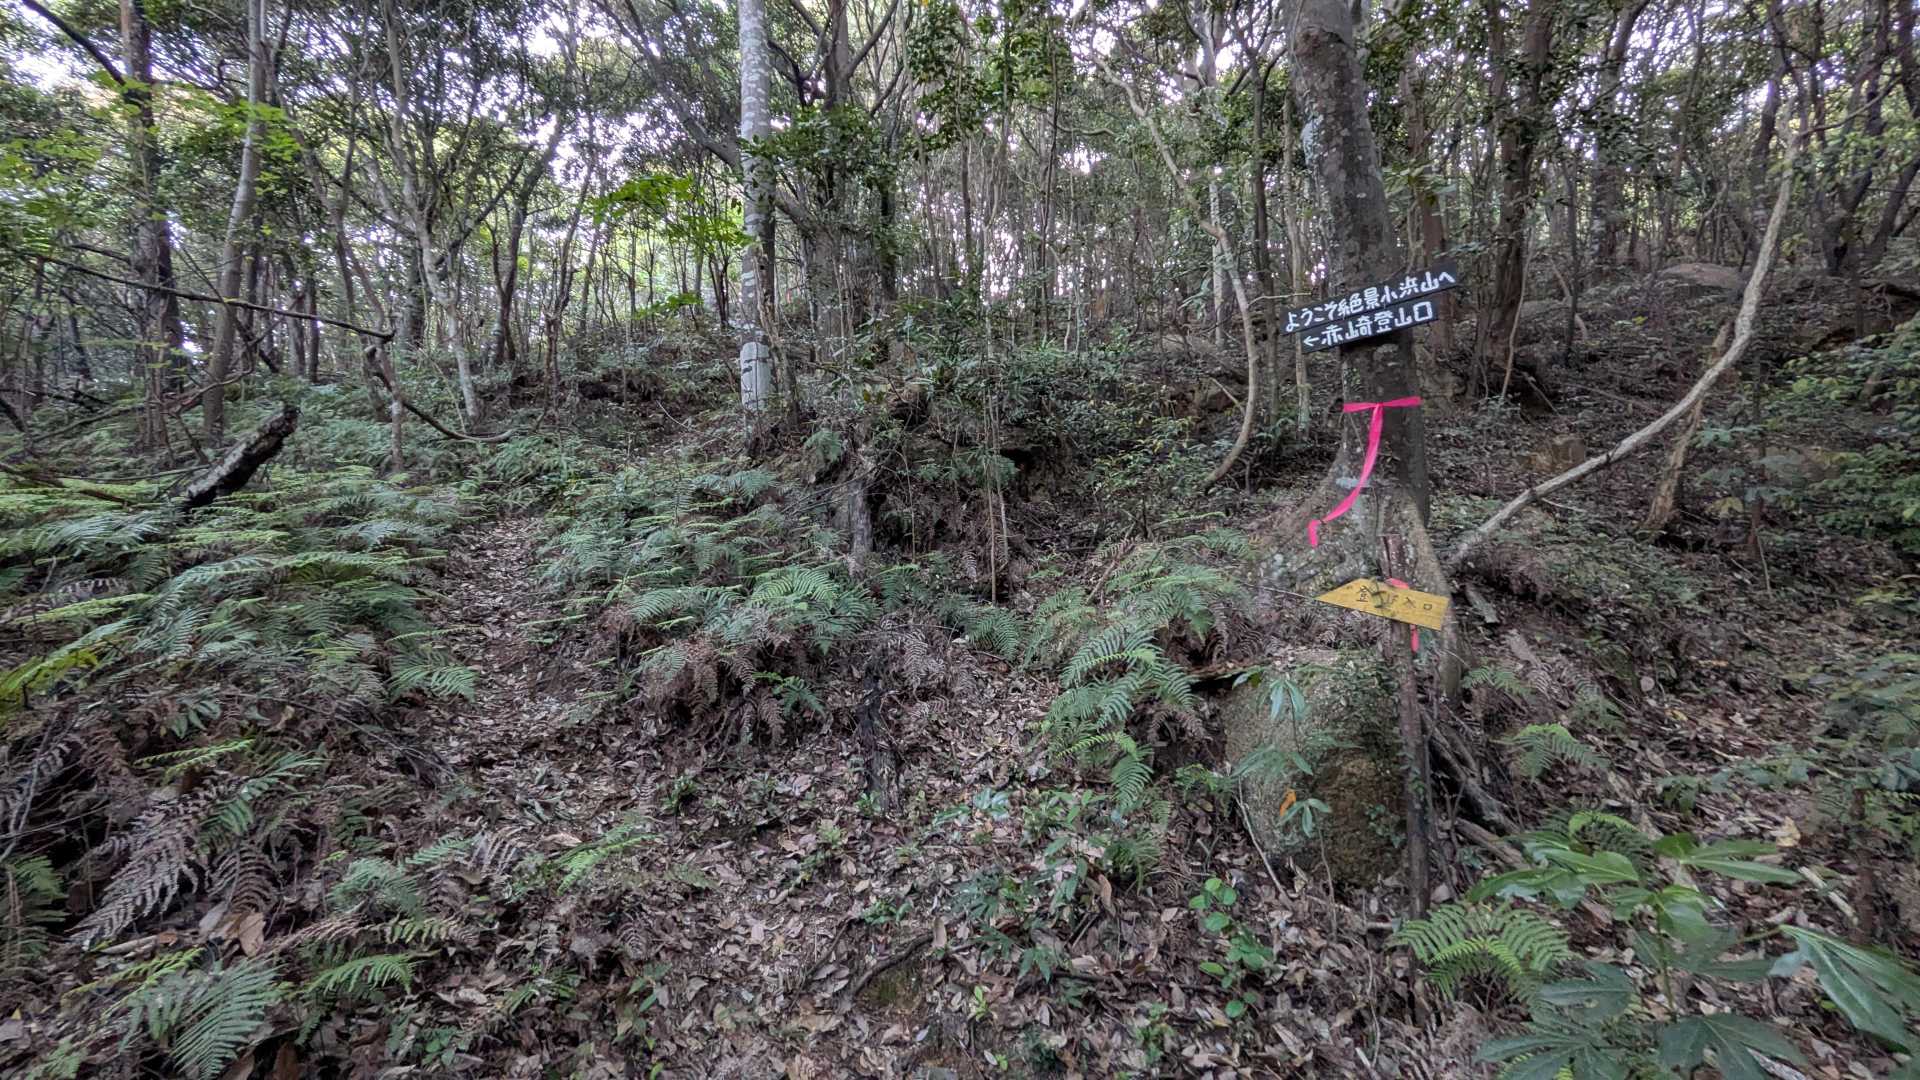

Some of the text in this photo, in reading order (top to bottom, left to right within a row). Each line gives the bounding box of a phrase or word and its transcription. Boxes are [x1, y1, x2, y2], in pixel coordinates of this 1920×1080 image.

[1286, 271, 1455, 332] ようこそ絶景小浜山へ
[1321, 301, 1434, 346] 赤崎登山口
